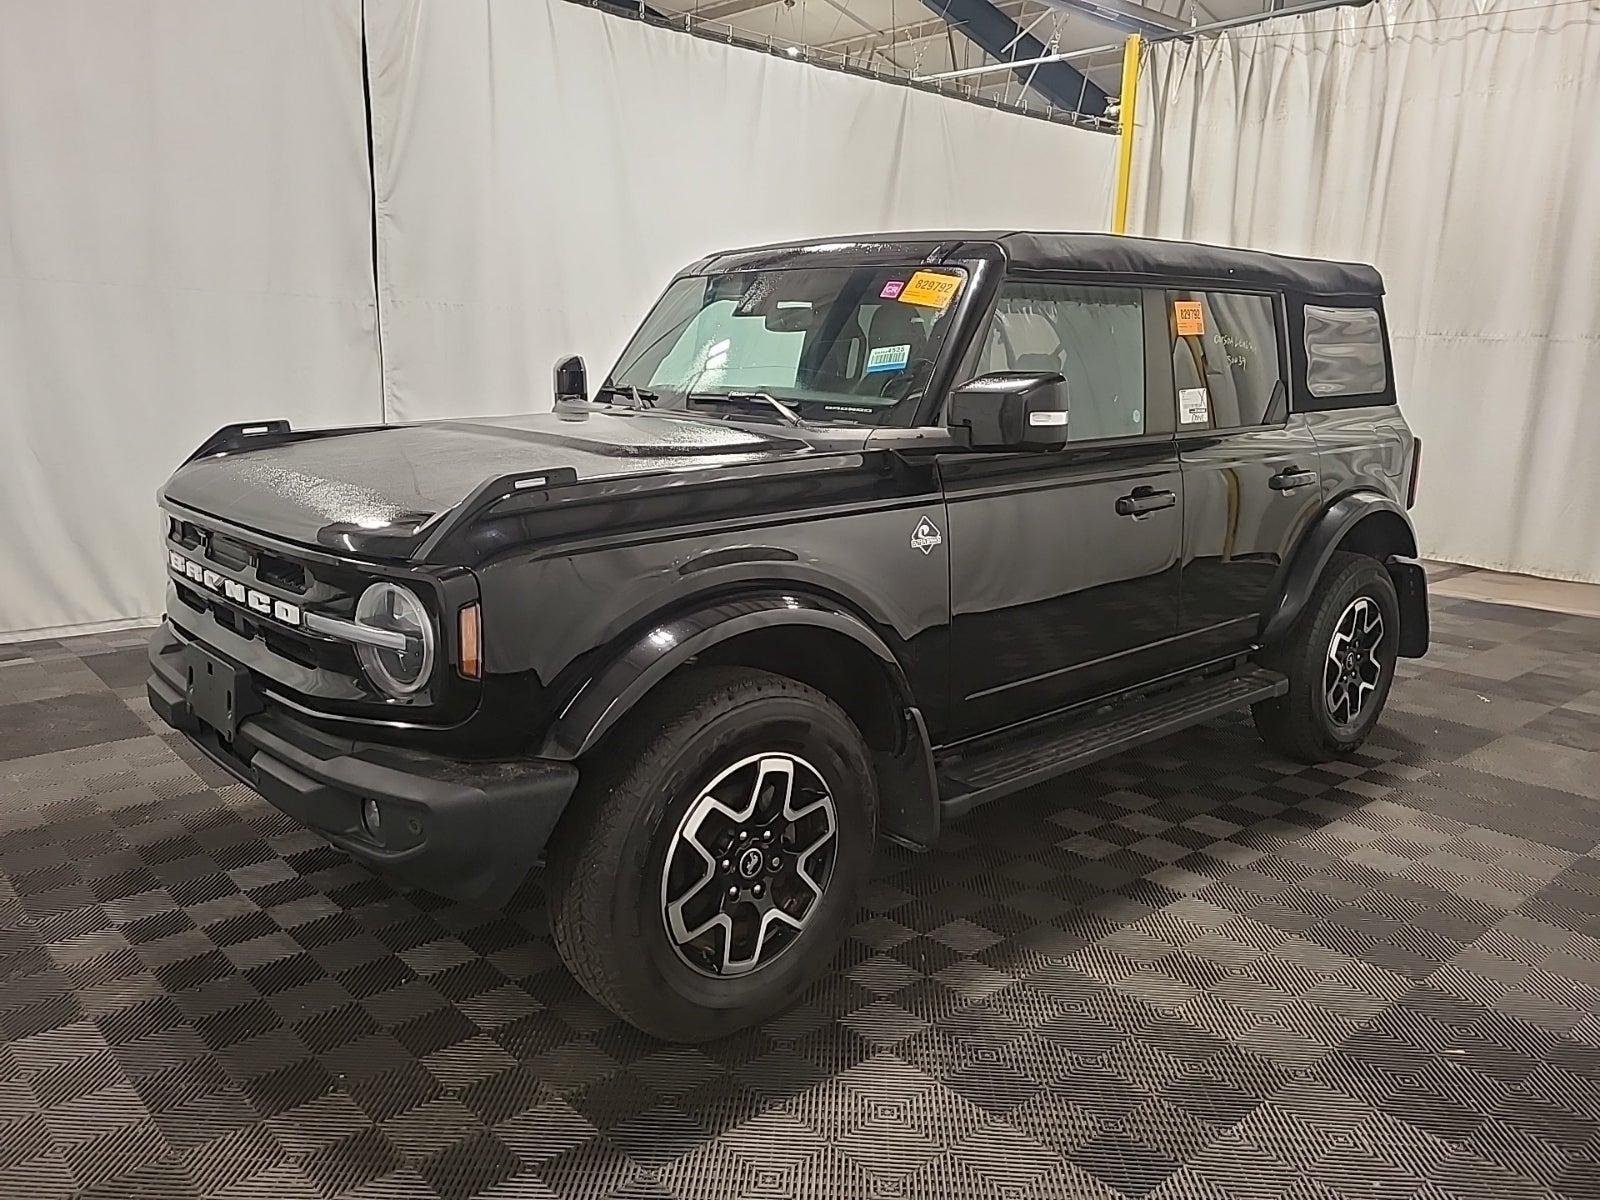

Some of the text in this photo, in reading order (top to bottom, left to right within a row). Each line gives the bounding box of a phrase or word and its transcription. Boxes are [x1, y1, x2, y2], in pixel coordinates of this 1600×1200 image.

[885, 286, 899, 294] CR
[915, 279, 953, 294] 829792
[1180, 308, 1201, 320] 829792
[824, 405, 873, 413] BRONCO
[169, 550, 300, 625] BRONCO
